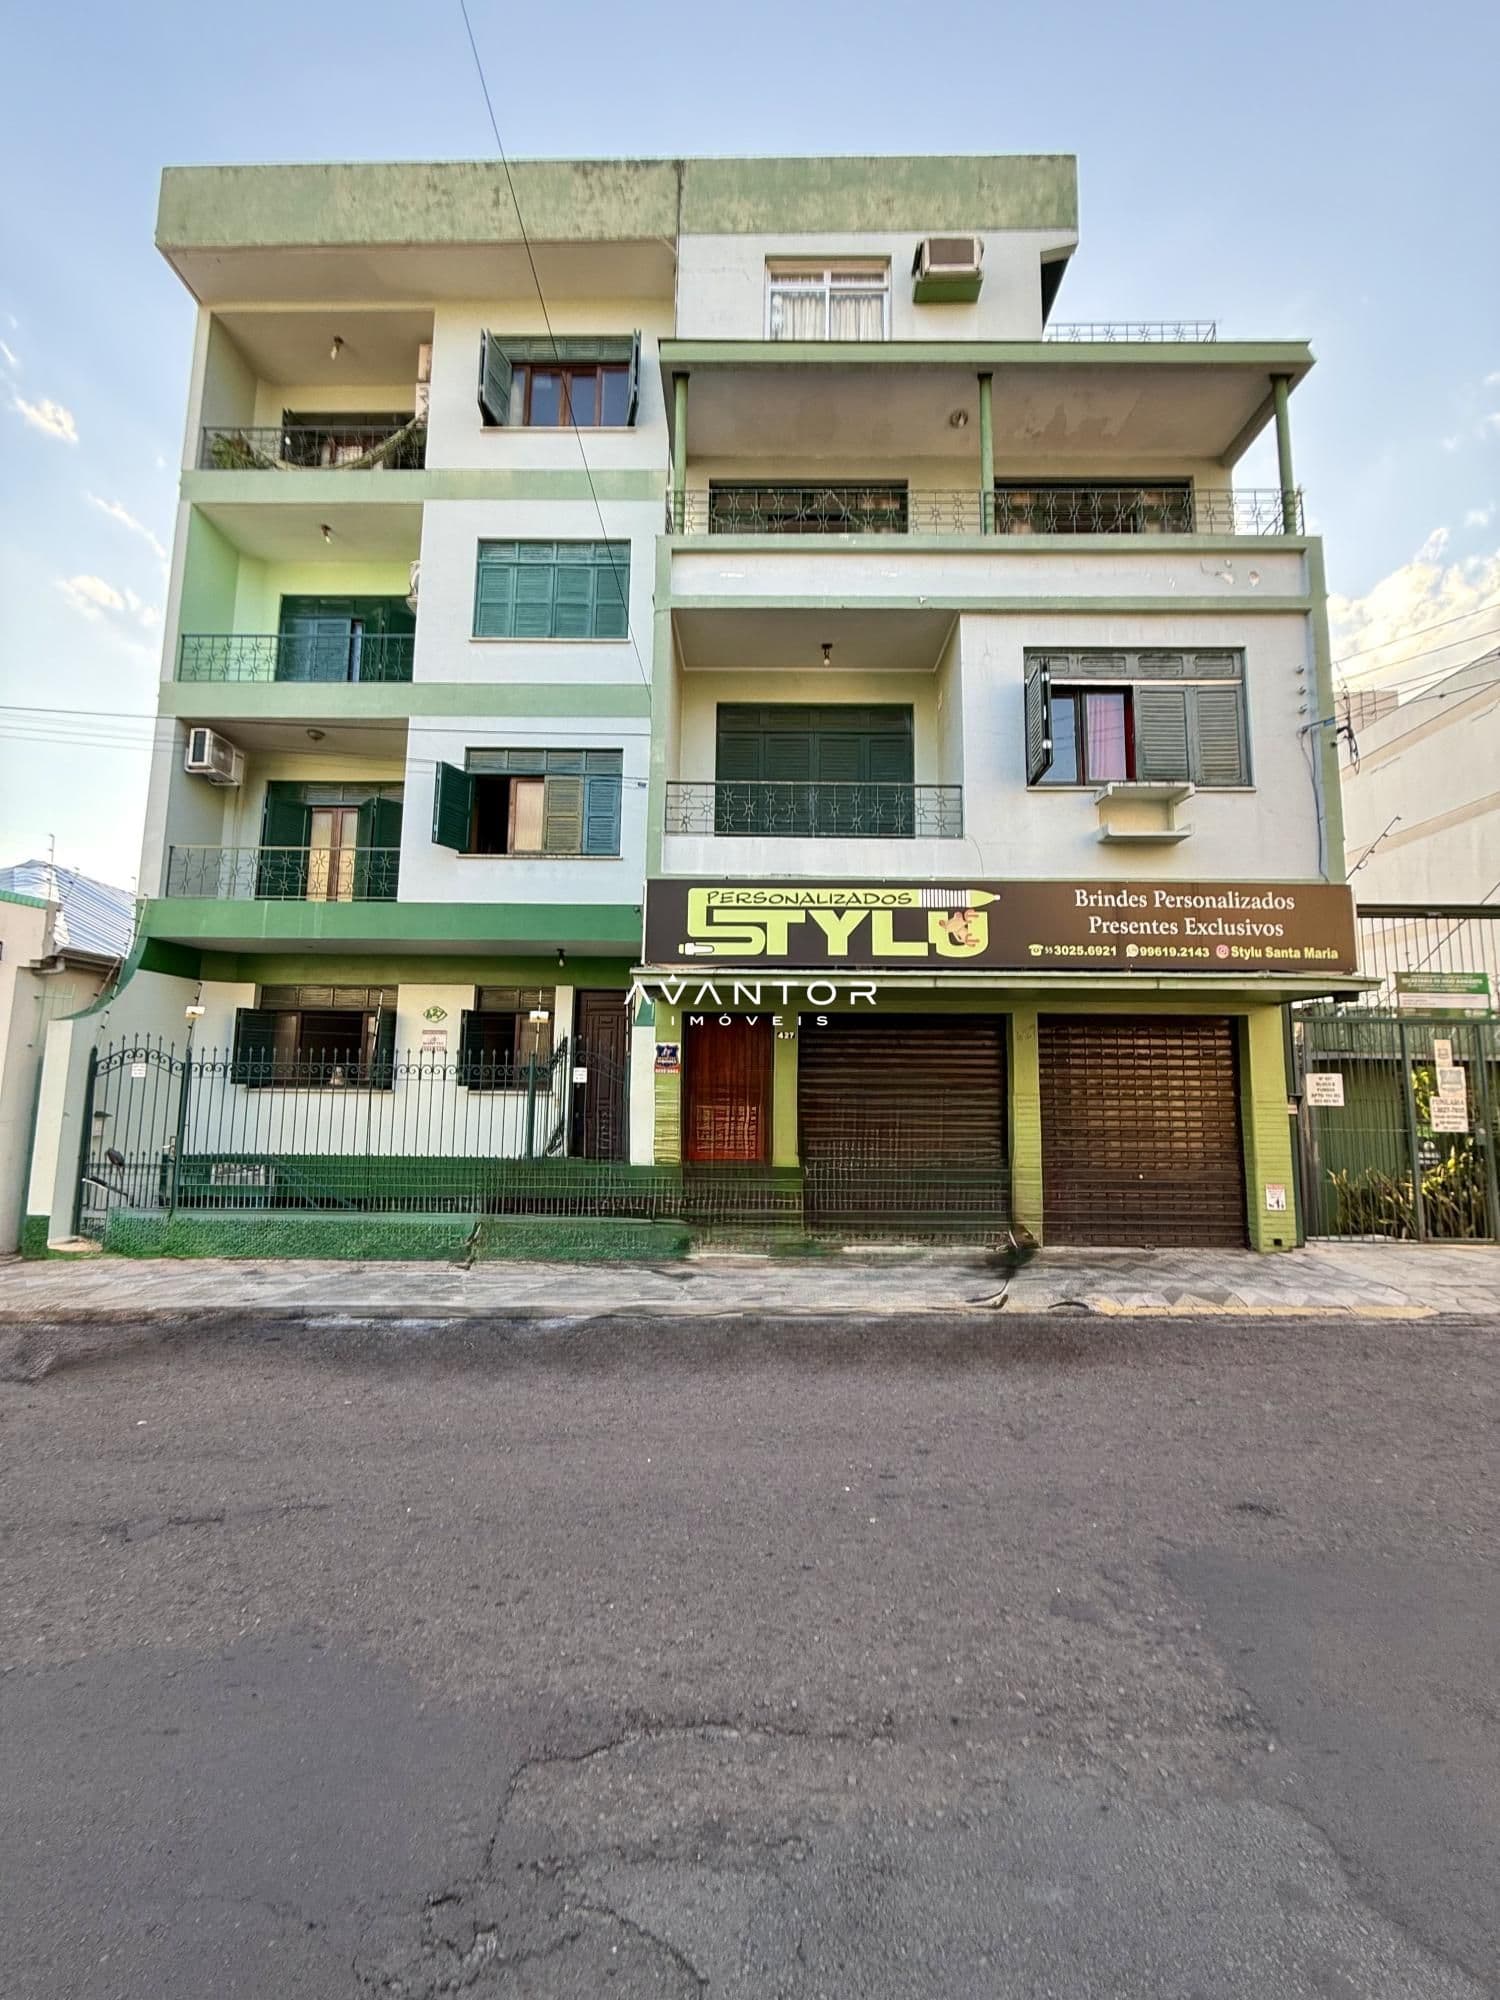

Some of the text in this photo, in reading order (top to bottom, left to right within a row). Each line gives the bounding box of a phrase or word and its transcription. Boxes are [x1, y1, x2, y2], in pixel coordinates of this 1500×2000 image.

[706, 890, 913, 906] PERSONALIZADOS
[1074, 888, 1296, 911] Brindes Personalizados
[1088, 915, 1285, 938] Presentes Exclusivos
[1139, 946, 1210, 959] 99619.2143
[1230, 945, 1262, 960] Stylu
[1264, 946, 1302, 960] Santa
[1303, 946, 1339, 960] Maria
